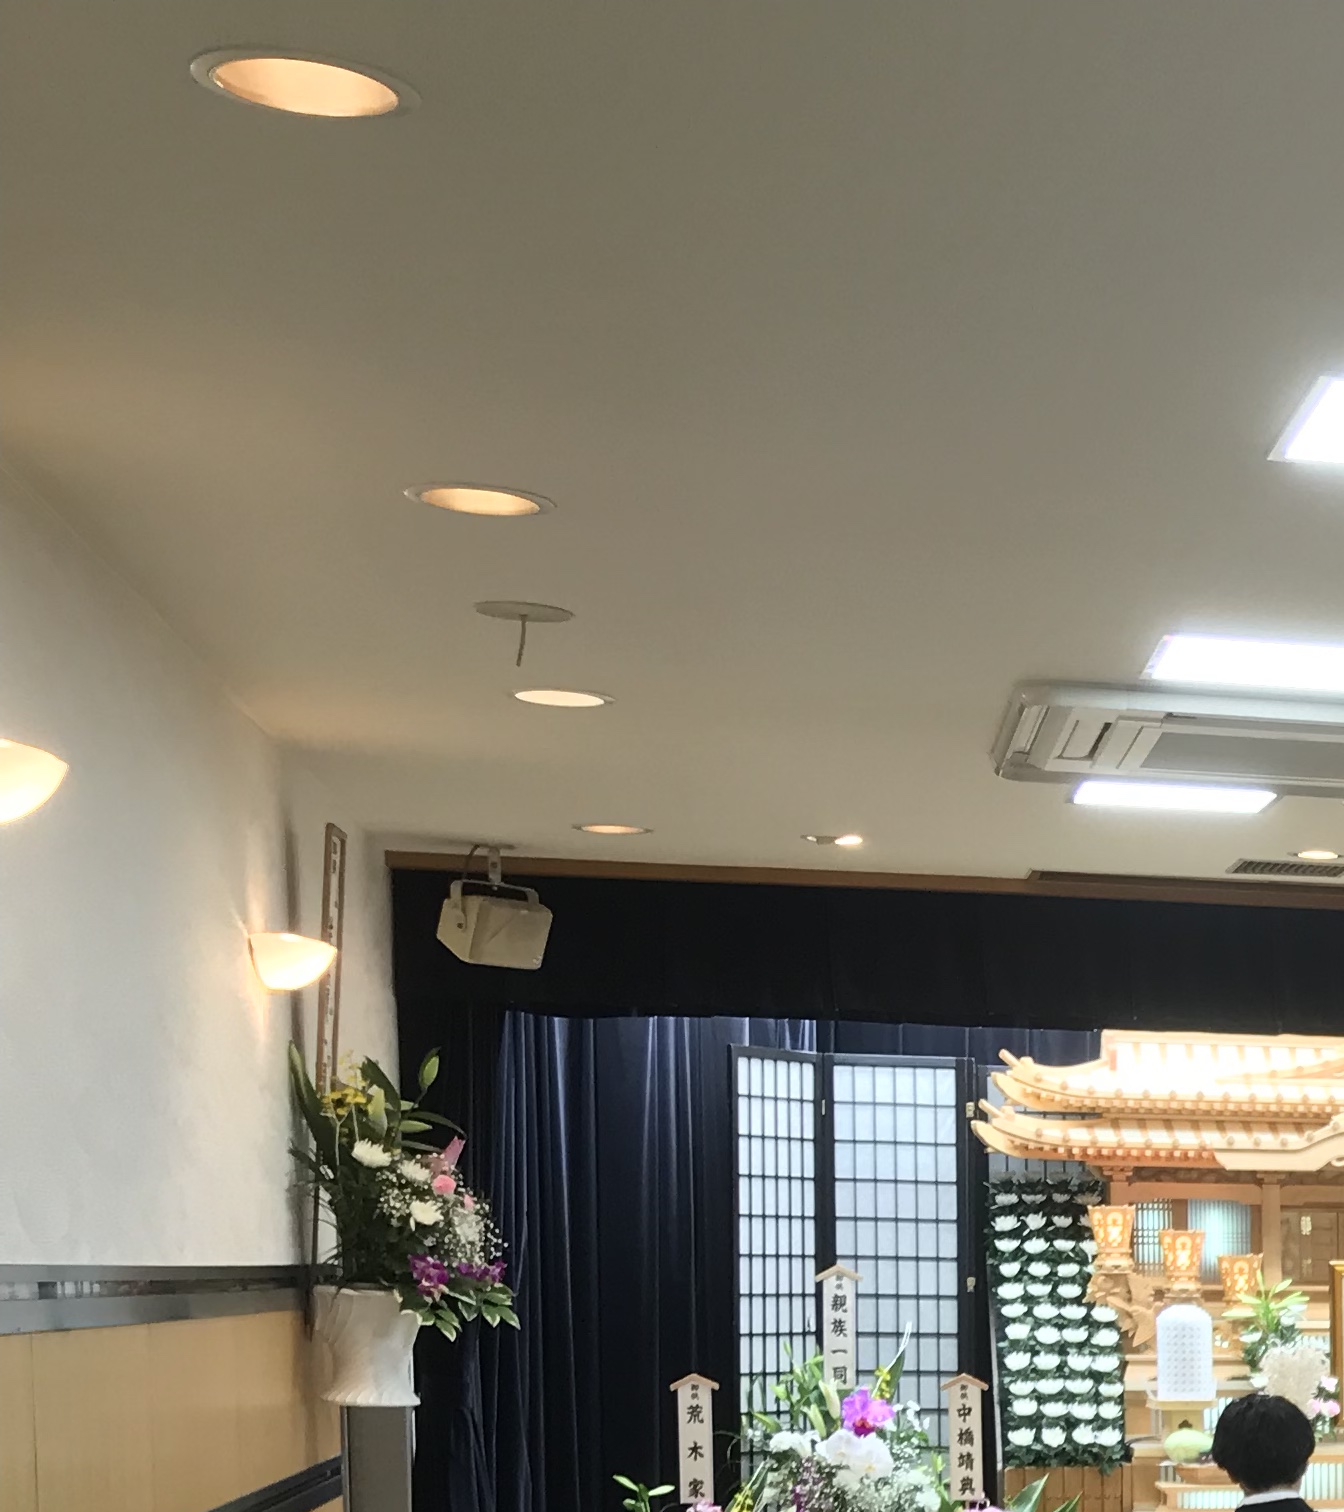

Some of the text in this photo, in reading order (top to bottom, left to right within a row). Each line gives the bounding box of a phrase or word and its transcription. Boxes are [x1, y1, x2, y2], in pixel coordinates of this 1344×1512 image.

[830, 1294, 848, 1385] 親族一同
[686, 1403, 706, 1499] 荒木家
